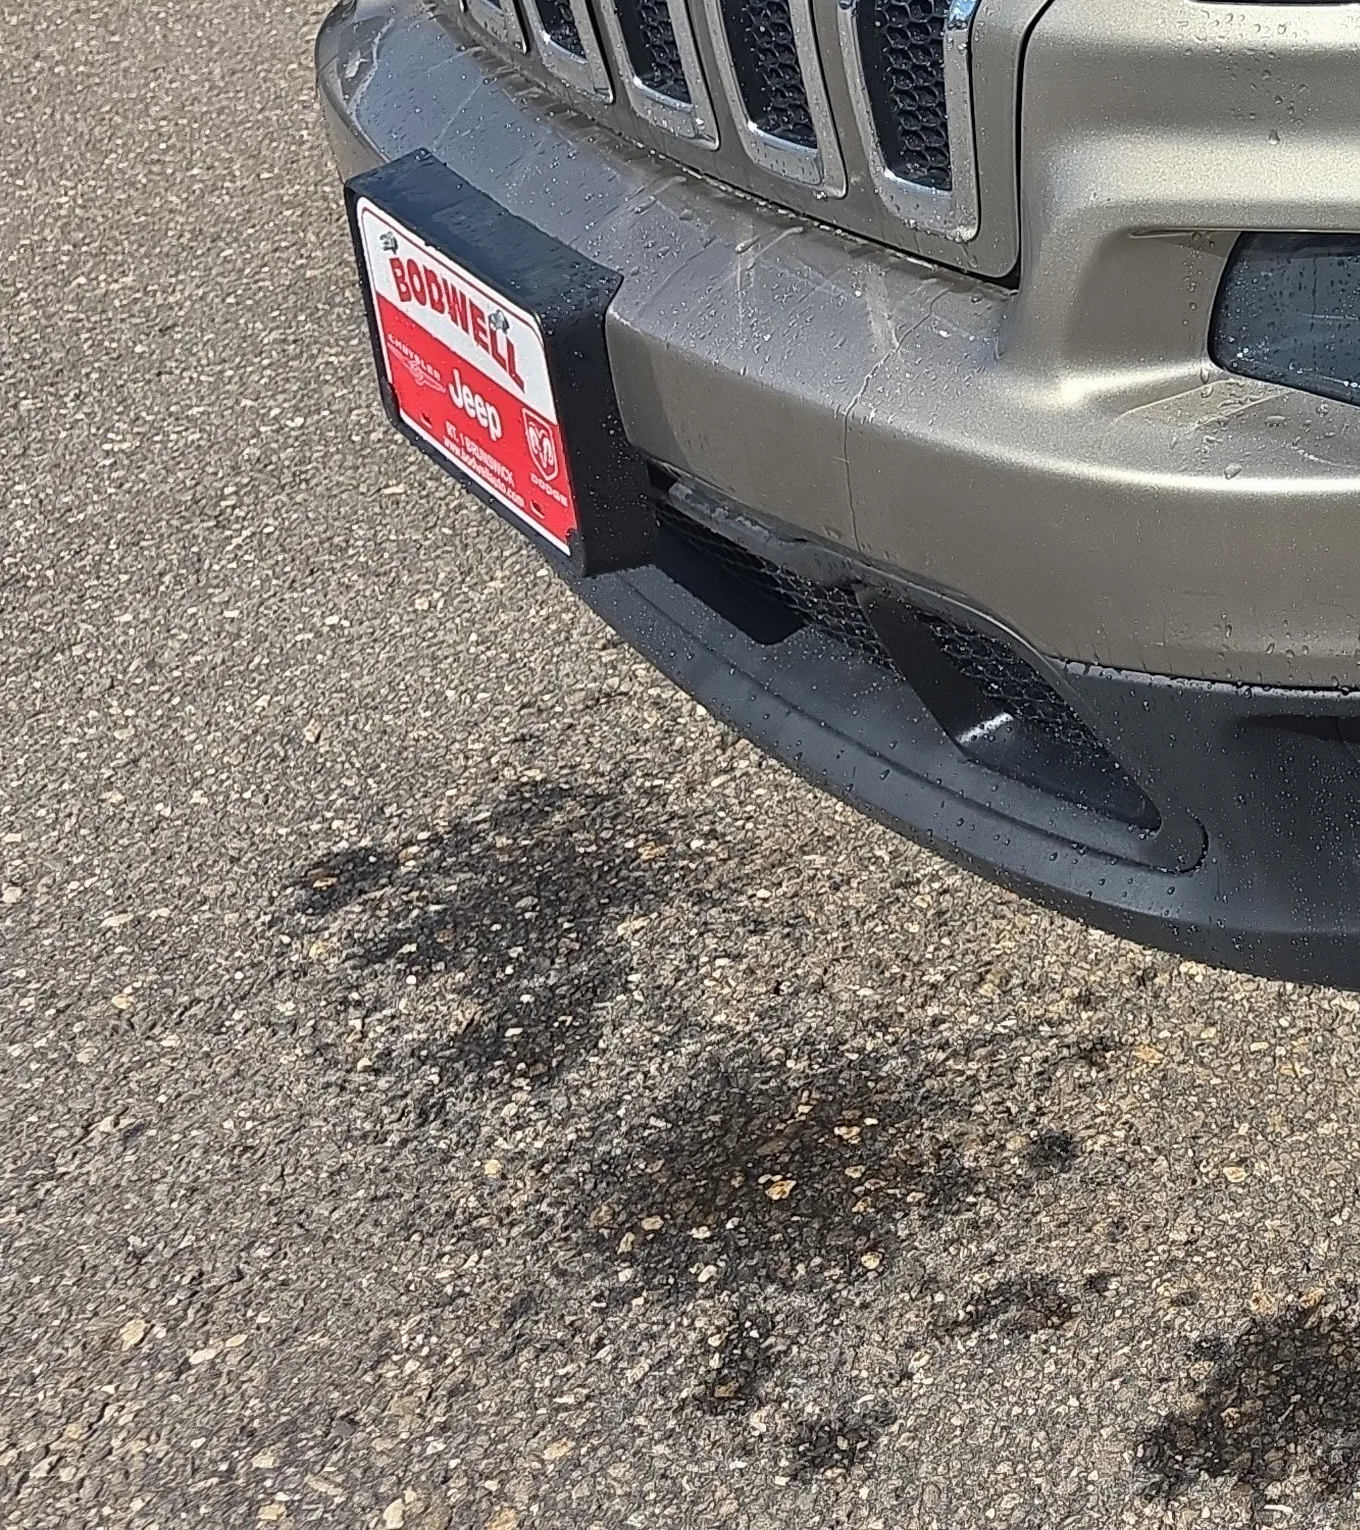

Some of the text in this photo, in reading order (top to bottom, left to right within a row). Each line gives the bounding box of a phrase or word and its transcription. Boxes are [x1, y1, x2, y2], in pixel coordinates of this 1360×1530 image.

[389, 257, 525, 393] BODWELL
[447, 368, 503, 442] Jeep
[529, 471, 569, 508] DODGE
